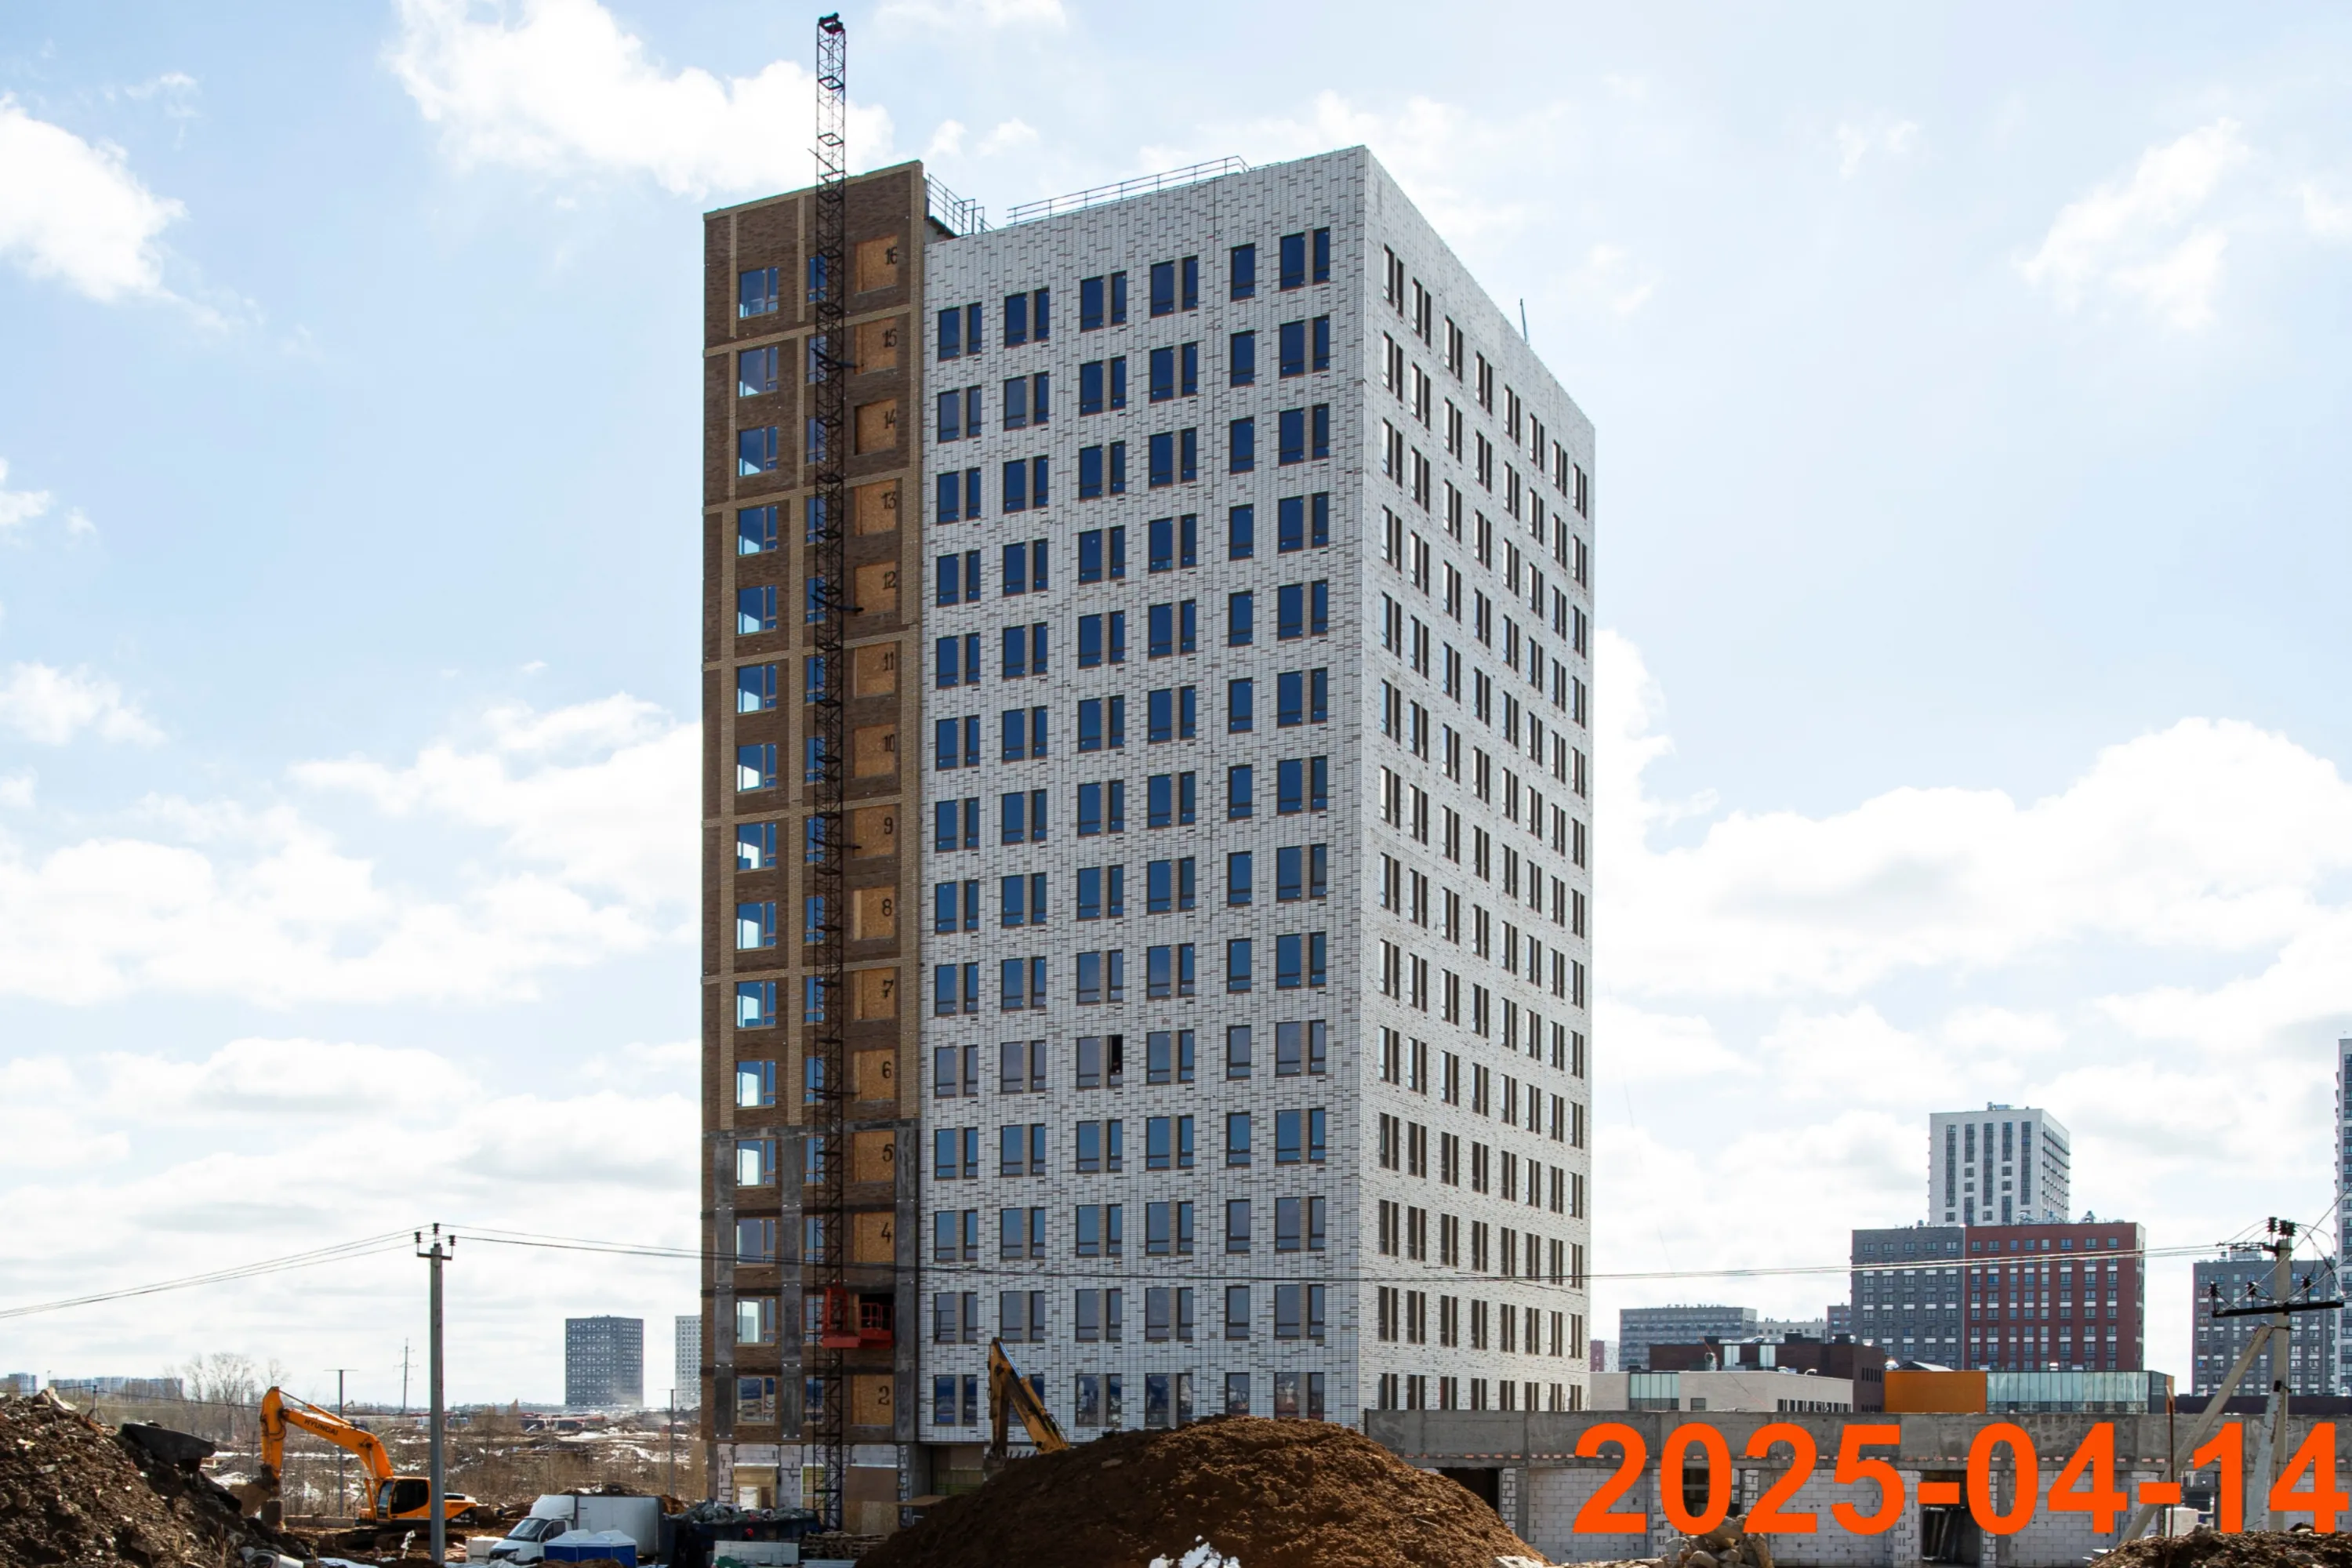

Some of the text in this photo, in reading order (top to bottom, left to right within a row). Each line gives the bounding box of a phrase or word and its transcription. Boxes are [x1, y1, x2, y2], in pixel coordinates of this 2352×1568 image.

[883, 328, 897, 348] 15
[884, 408, 896, 429] 14
[882, 492, 897, 510] 13
[882, 571, 897, 590] 12
[883, 652, 894, 670] 11
[884, 734, 895, 753] 10
[884, 817, 893, 834] 9
[882, 898, 892, 916] 8
[883, 979, 894, 997] 7
[882, 1061, 891, 1079] 6
[882, 1143, 895, 1162] 5
[880, 1222, 892, 1243] 4
[878, 1385, 890, 1406] 2
[304, 1418, 339, 1436] HYUNDAI
